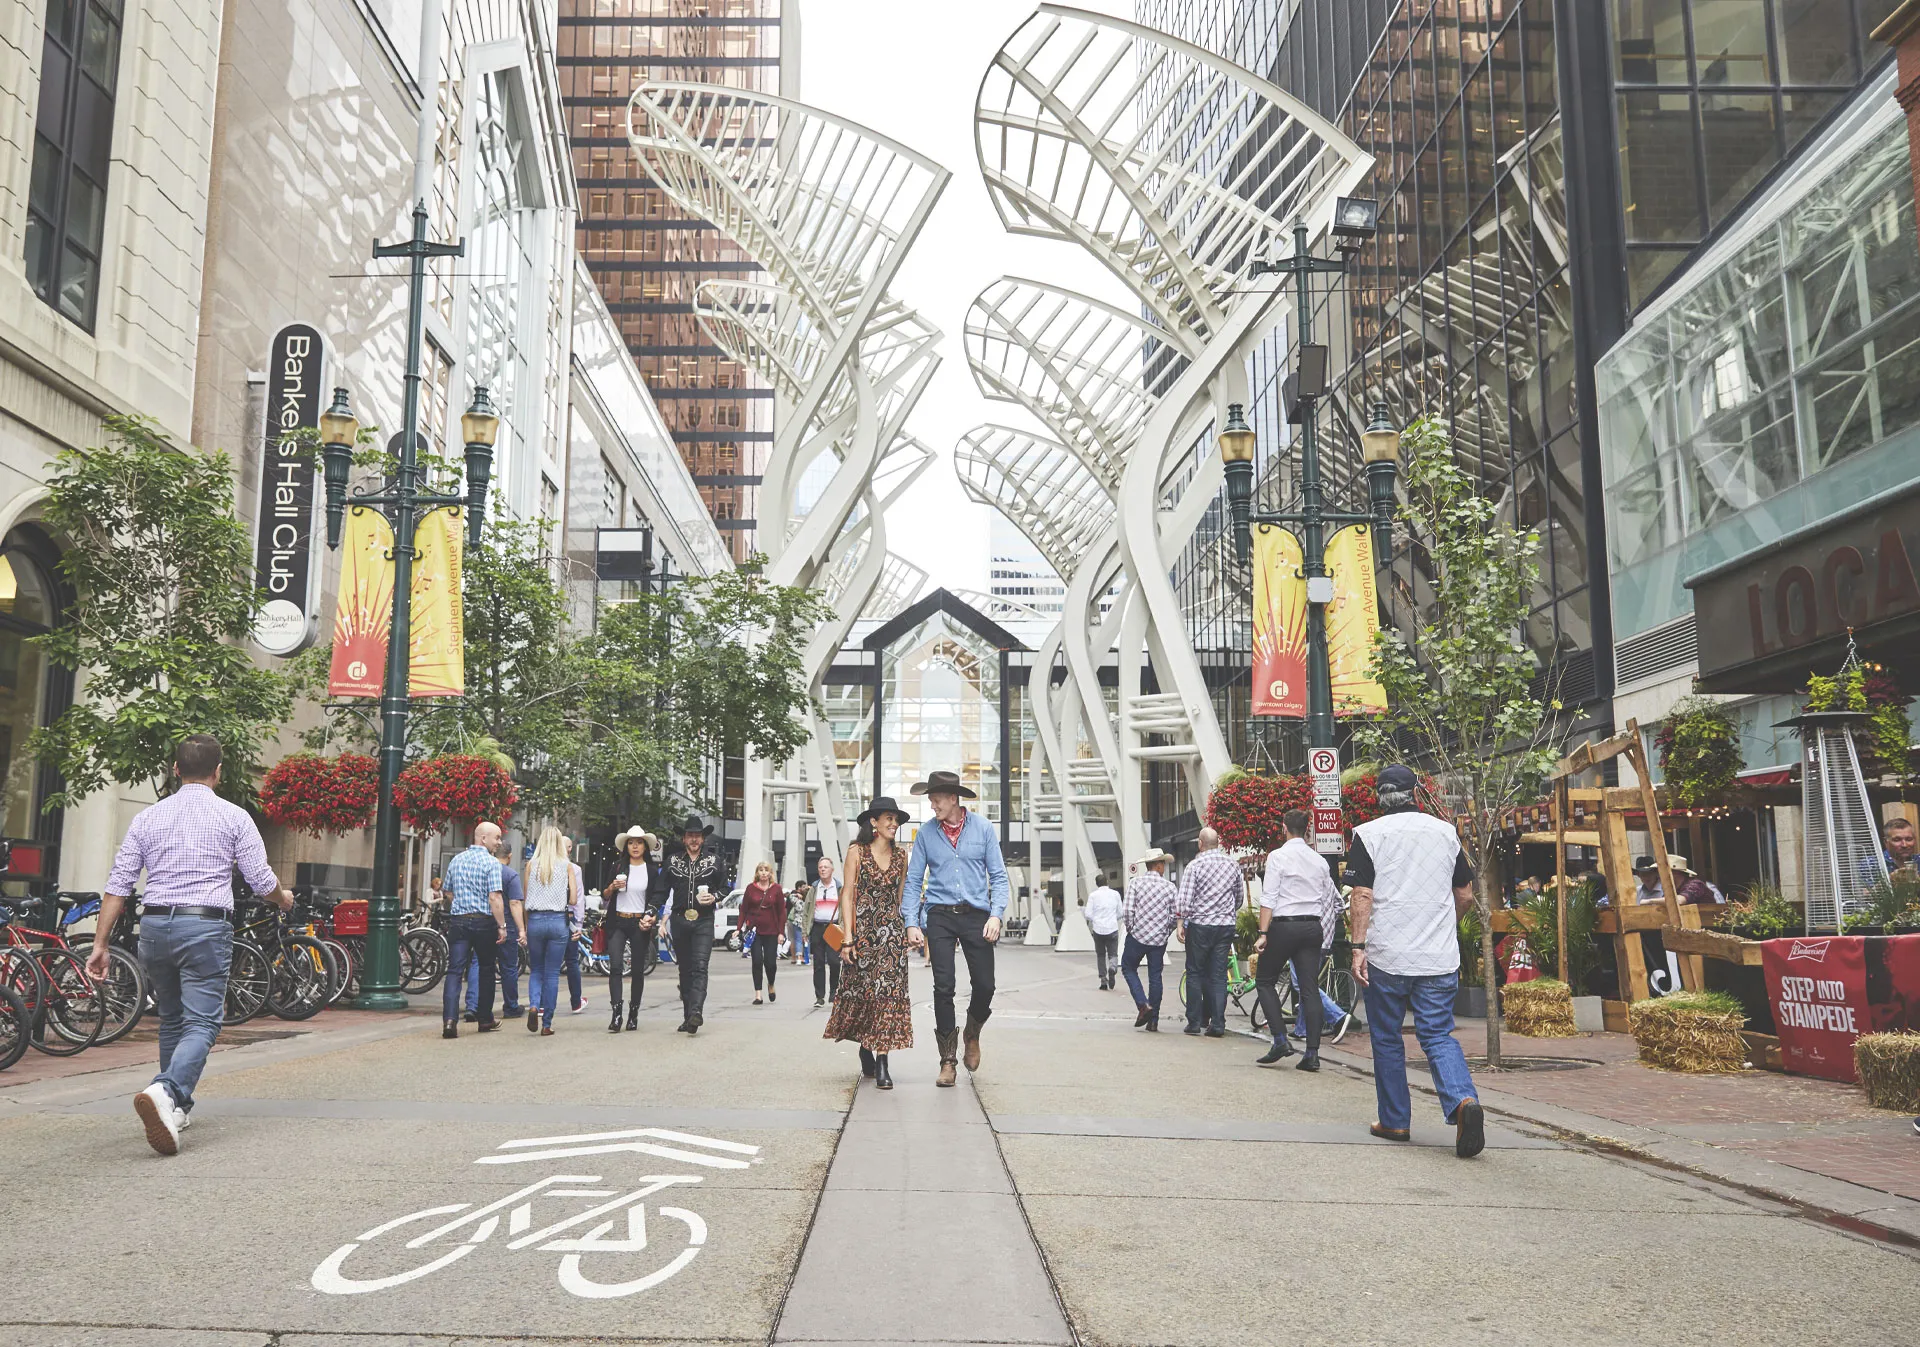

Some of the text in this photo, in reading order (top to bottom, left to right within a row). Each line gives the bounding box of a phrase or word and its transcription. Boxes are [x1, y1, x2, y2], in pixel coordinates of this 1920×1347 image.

[274, 462, 302, 517] Hall
[269, 523, 298, 593] Club
[447, 545, 459, 596] Avenue
[1361, 564, 1375, 614] Avenue
[1747, 527, 1920, 658] LOCA
[446, 600, 461, 656] Stephen
[332, 681, 361, 689] downtown
[1284, 702, 1303, 710] calgary
[1318, 812, 1336, 821] TAXI
[1318, 822, 1338, 830] ONLY
[1792, 944, 1826, 955] Budweiser
[1781, 976, 1845, 1002] STEP INTO
[1779, 1001, 1859, 1033] STAMPEDE
